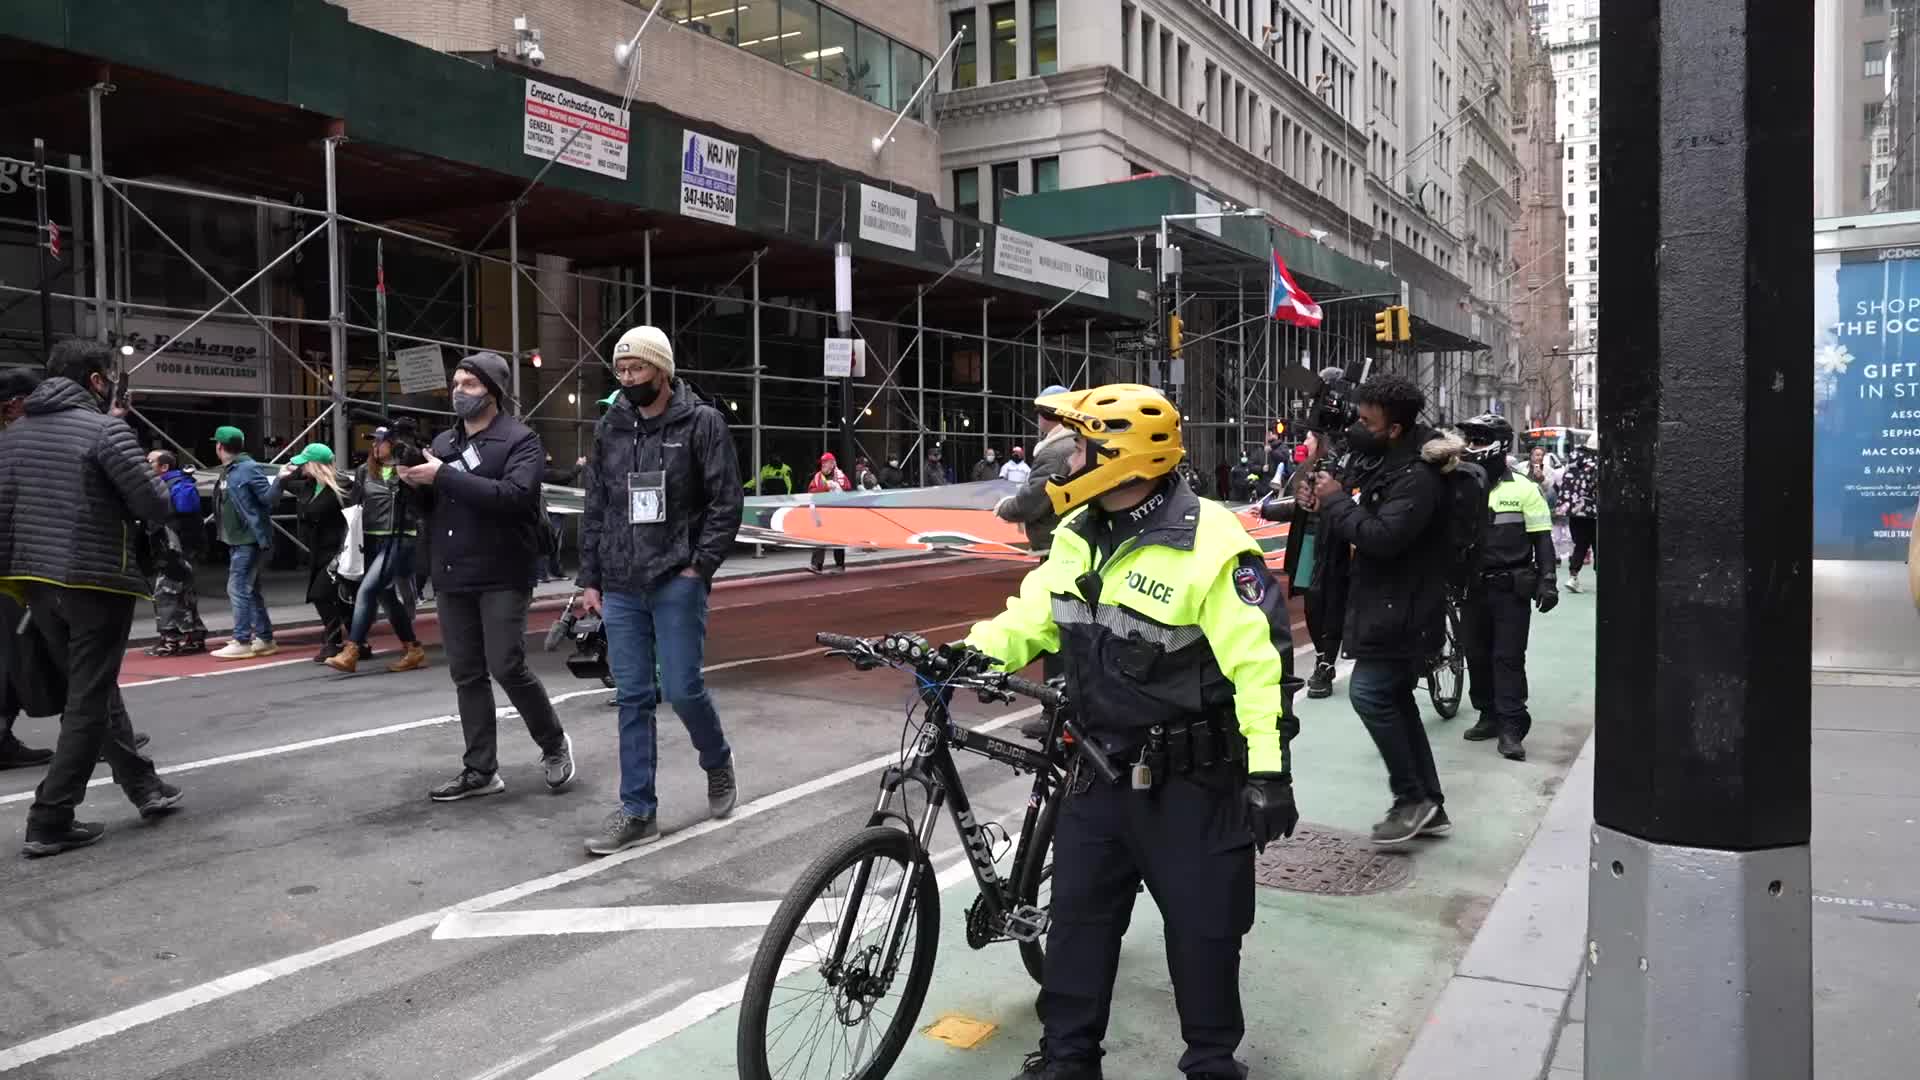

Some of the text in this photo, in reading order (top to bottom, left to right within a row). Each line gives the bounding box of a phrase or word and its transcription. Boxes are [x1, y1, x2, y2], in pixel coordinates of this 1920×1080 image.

[530, 84, 556, 103] Empac
[557, 93, 597, 119] Contracting
[528, 118, 555, 135] GENERAL
[725, 147, 738, 170] NY
[684, 186, 734, 214] 347-445-3500
[1856, 298, 1920, 315] SHOP
[1834, 320, 1877, 336] THE
[156, 362, 182, 374] FOOD
[1860, 384, 1883, 399] IN
[1862, 448, 1887, 457] MAC
[1863, 466, 1913, 474] & MANY
[1129, 493, 1165, 521] NYPD
[1873, 530, 1896, 538] WORLD
[986, 738, 1027, 760] POLICE
[957, 808, 997, 884] NYPD
